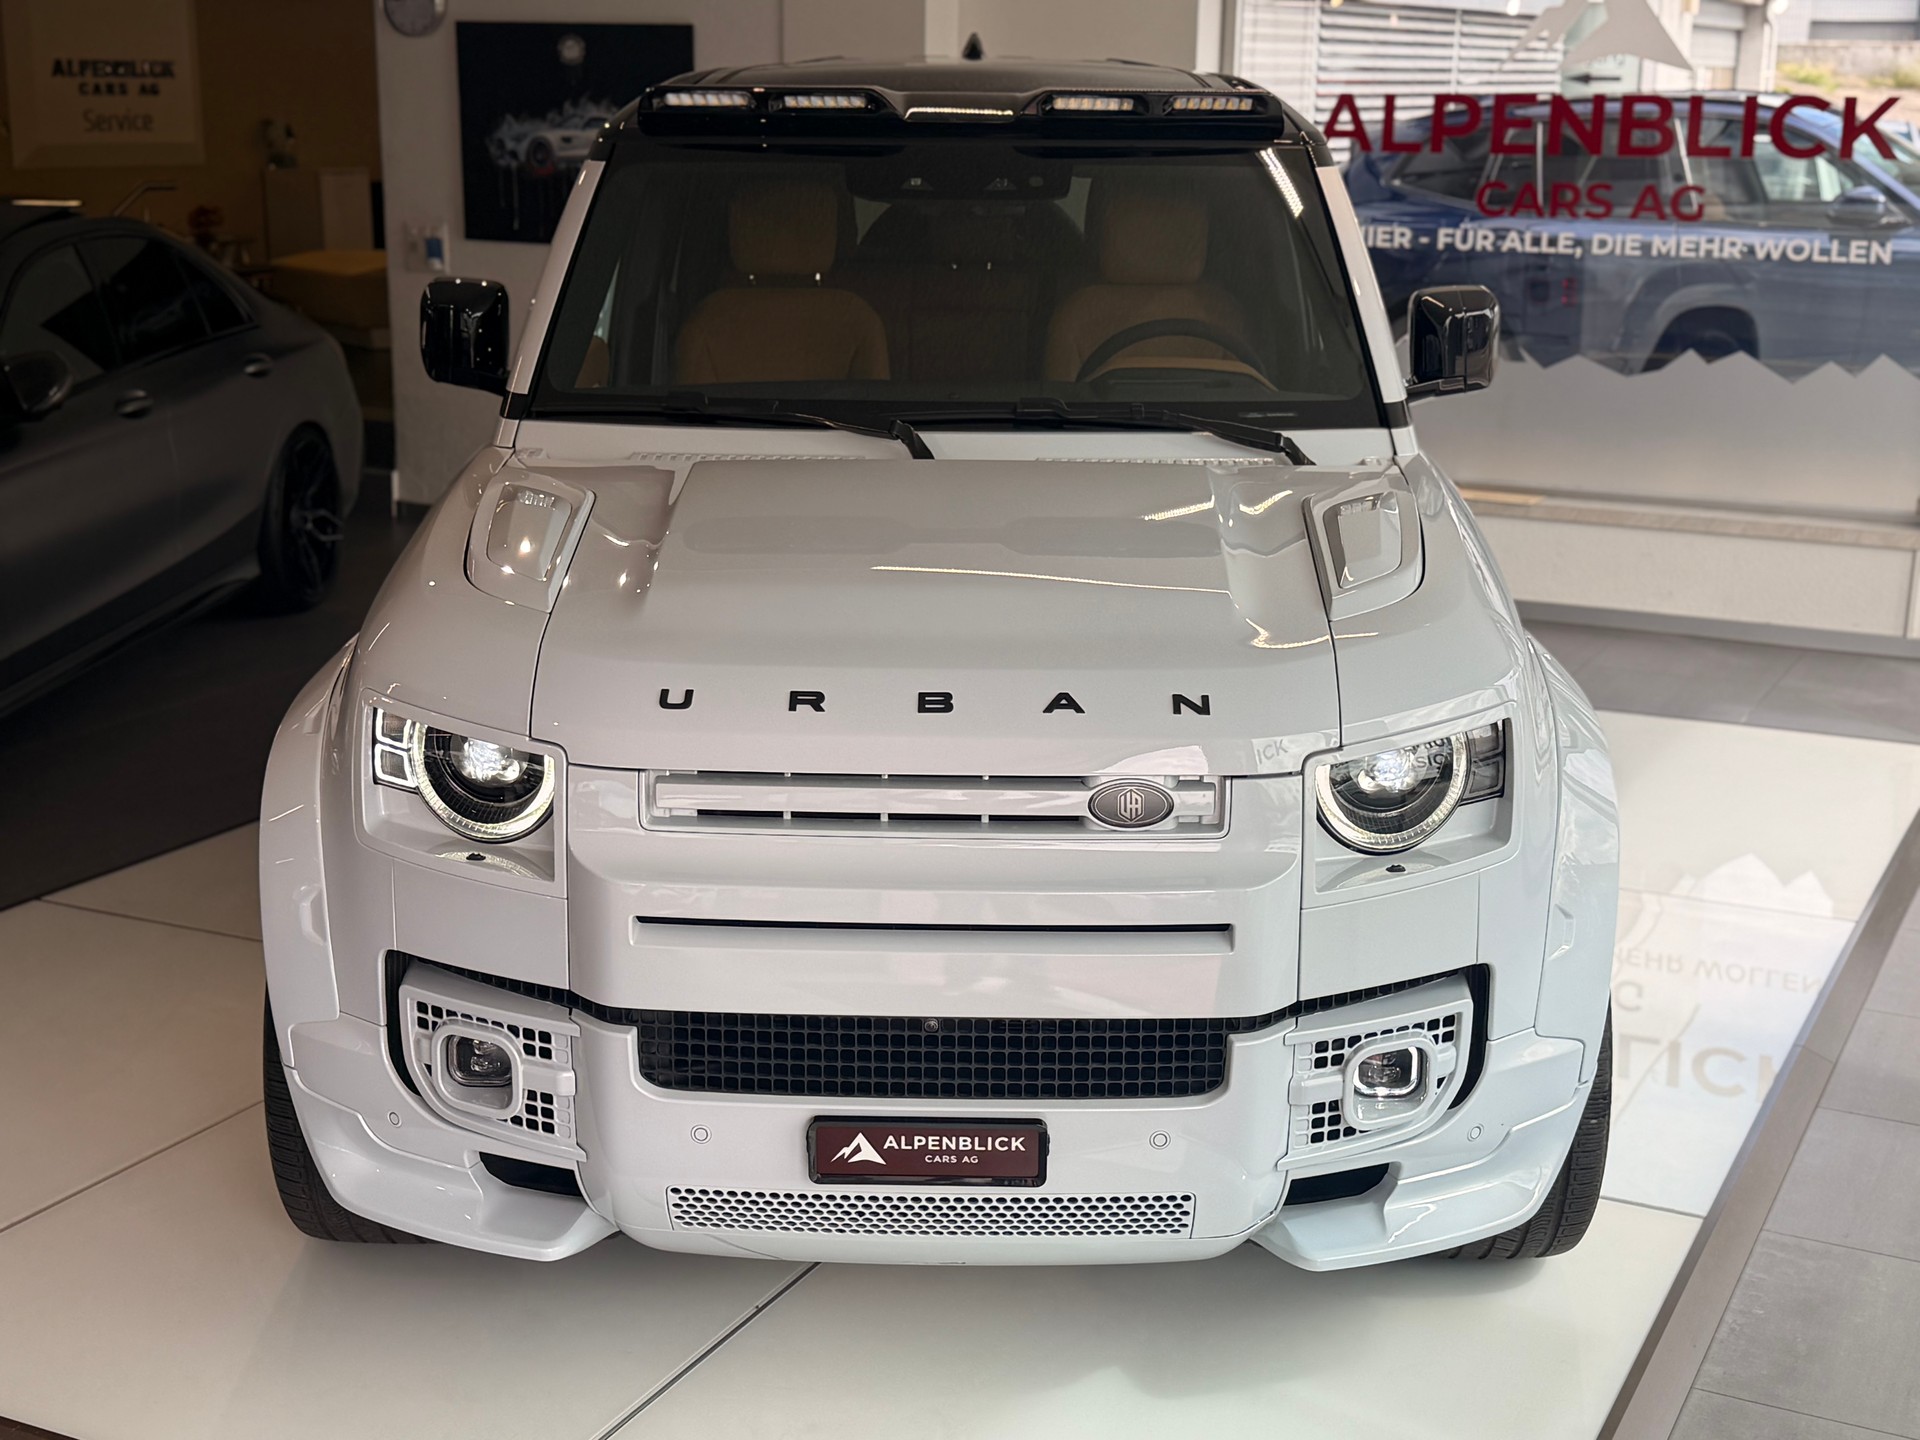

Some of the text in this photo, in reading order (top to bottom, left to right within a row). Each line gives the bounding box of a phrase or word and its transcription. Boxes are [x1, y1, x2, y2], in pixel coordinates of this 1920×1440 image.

[79, 82, 160, 96] CARS AG
[82, 108, 154, 132] Service
[1323, 93, 1900, 160] ALPENBLICK
[1475, 180, 1706, 222] CARS AG
[1436, 222, 1496, 252] FÜR
[1501, 231, 1583, 259] ALLE,
[1590, 233, 1642, 256] DIE
[1650, 235, 1743, 259] MEHR
[1752, 238, 1893, 265] WOLLEN
[658, 689, 1211, 716] URBAN
[883, 1135, 1026, 1151] ALPENBLICK
[925, 1154, 979, 1165] CARS AG
